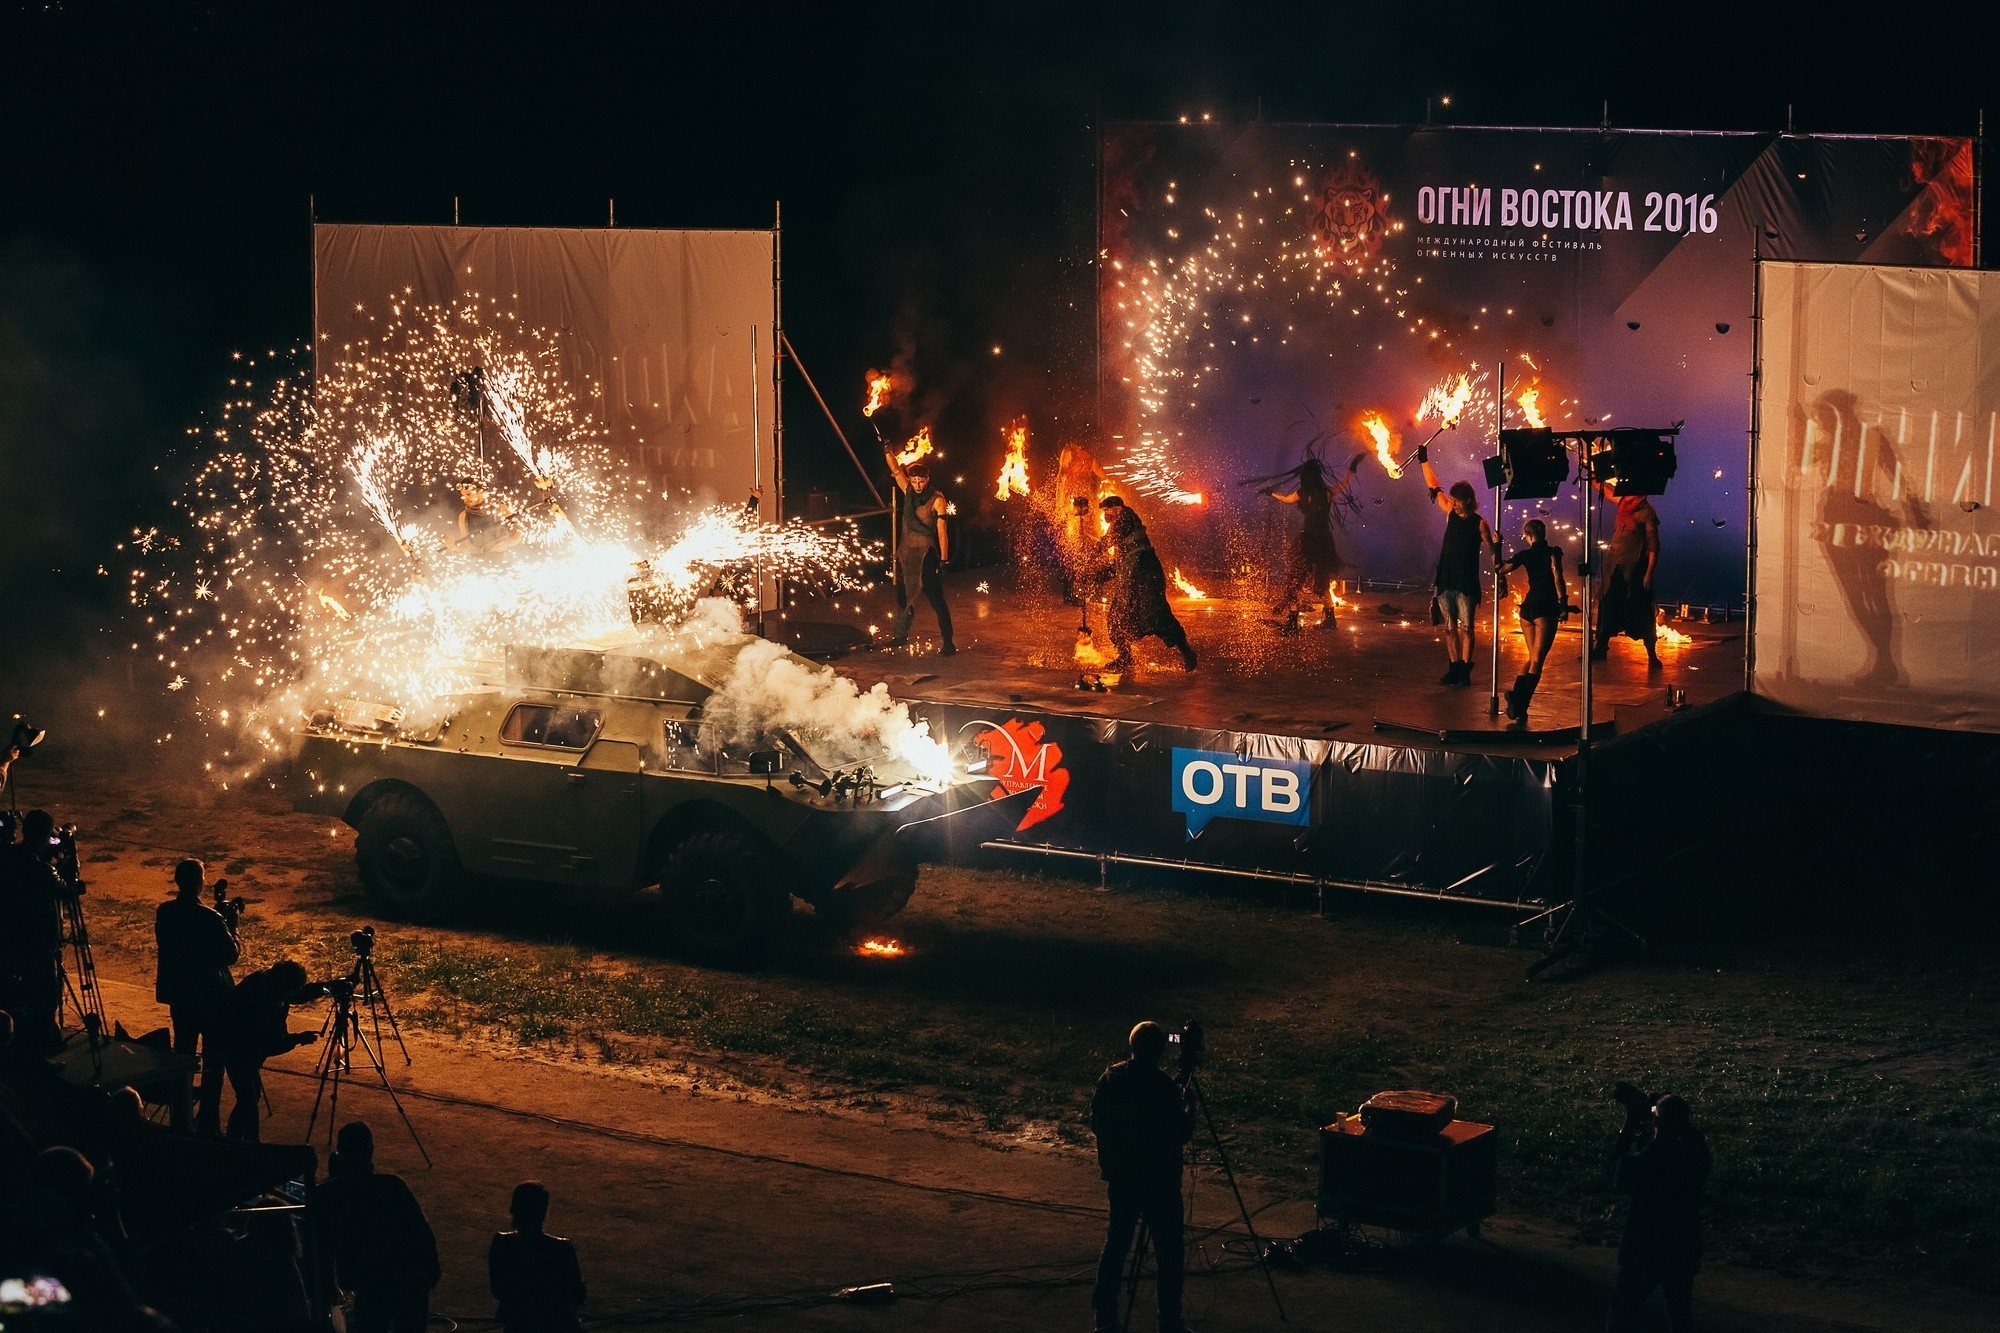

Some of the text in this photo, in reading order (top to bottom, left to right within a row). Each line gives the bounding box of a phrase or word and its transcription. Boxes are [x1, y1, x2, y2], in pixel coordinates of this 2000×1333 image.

[1417, 186, 1718, 234] ОГНИ ВОСТОКА 2016
[1417, 237, 1602, 250] МЕЖДУНАРОДНЫЙ ФЕСТИВАЛЬ
[1417, 250, 1557, 261] ОГНЕННЫХ ИСКУССТВ
[1182, 761, 1301, 813] ОТВ
